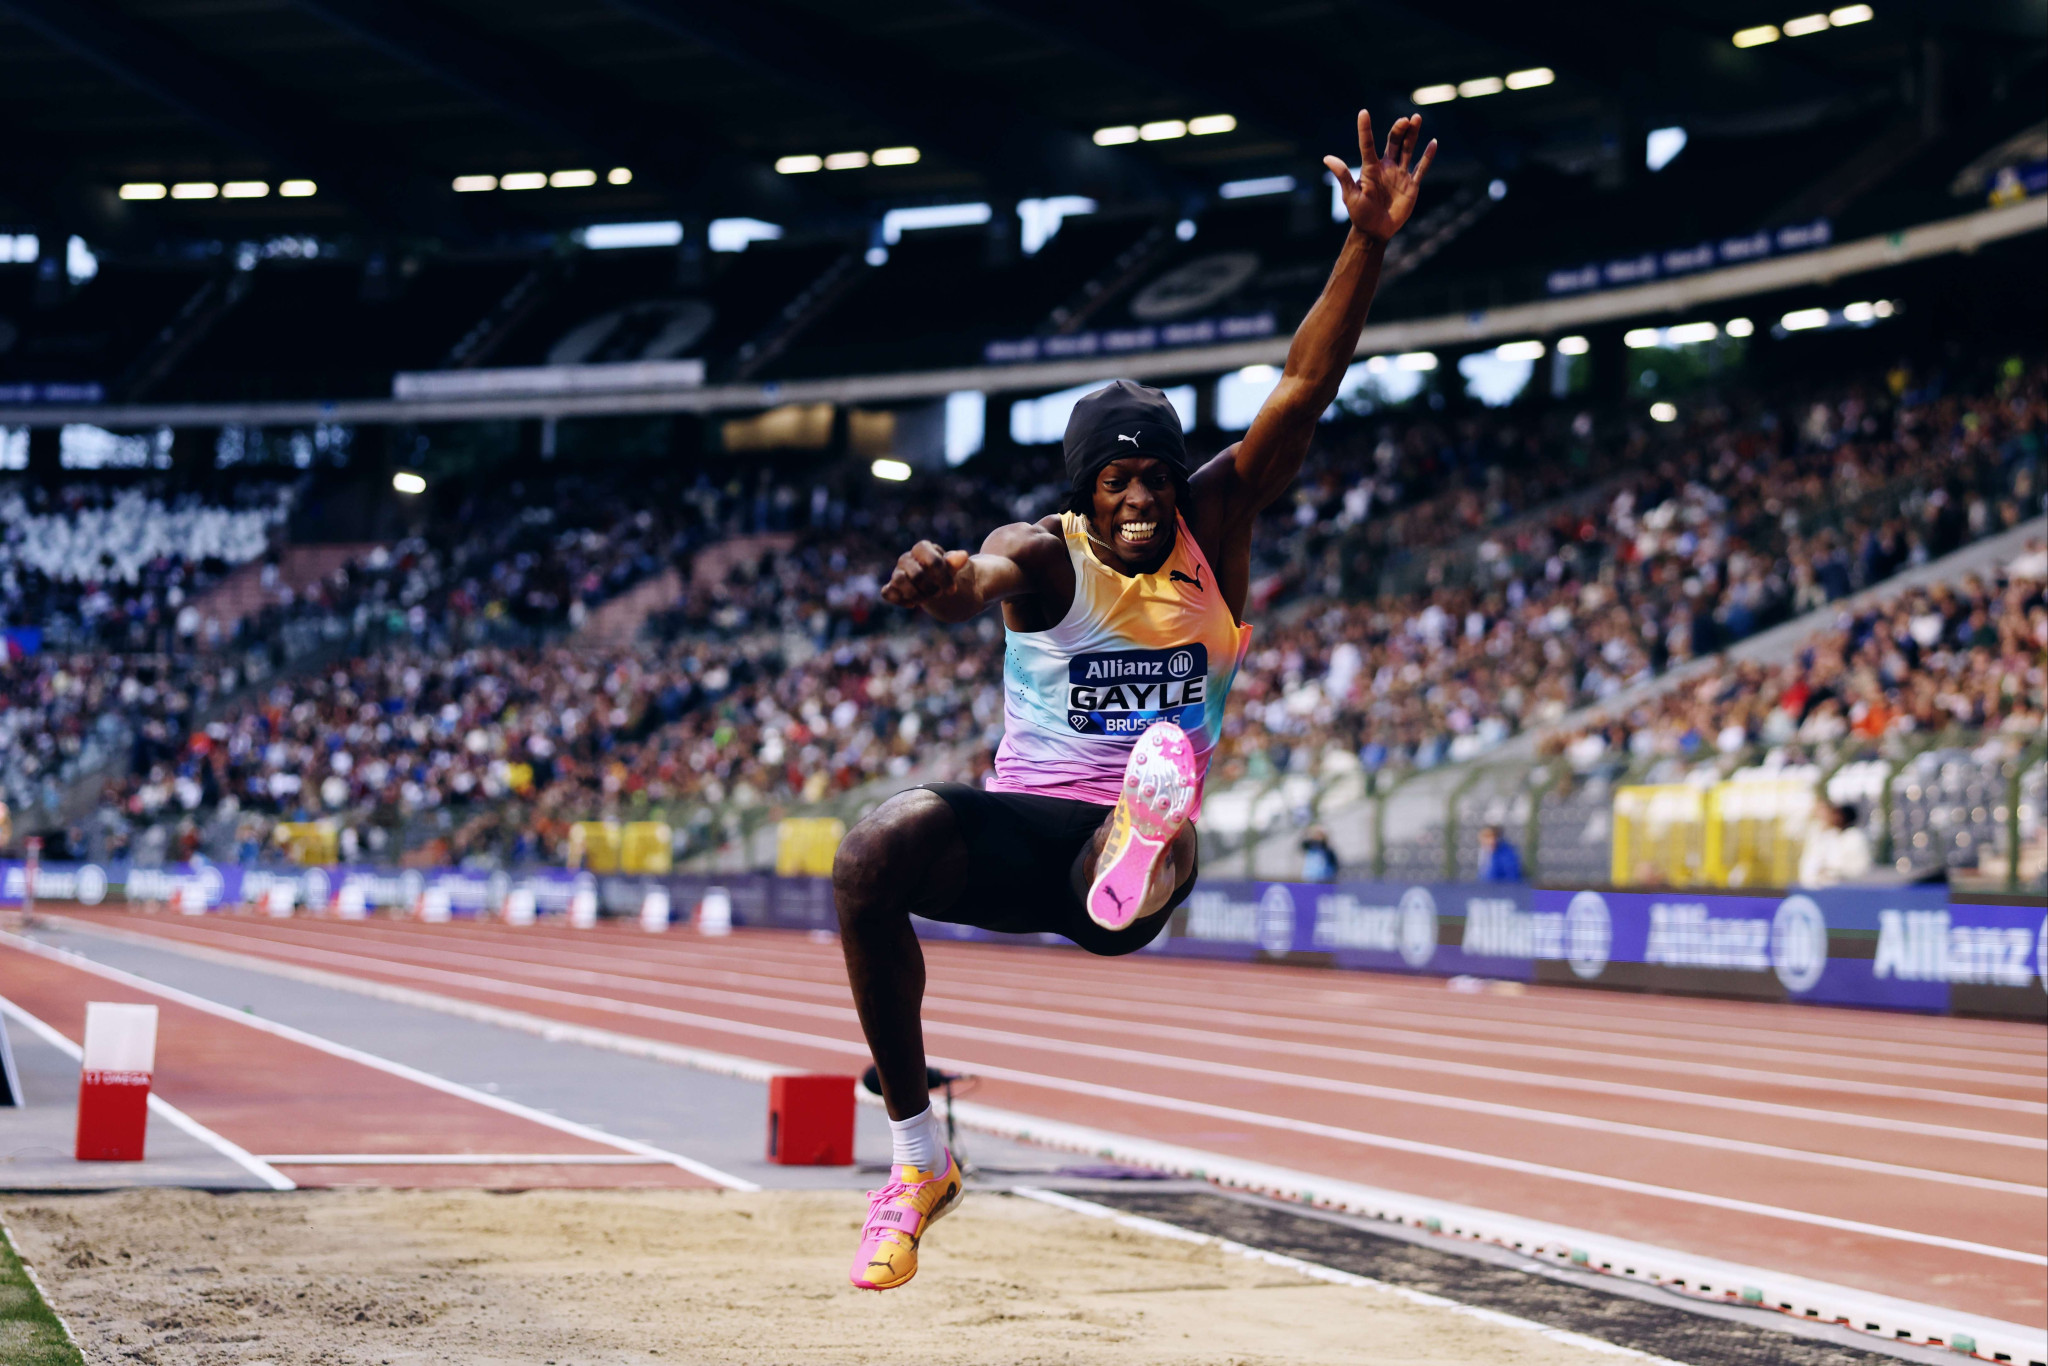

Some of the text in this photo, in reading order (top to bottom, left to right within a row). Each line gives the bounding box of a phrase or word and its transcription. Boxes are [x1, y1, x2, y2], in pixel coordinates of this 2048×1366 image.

[1085, 658, 1163, 679] Allianz
[1070, 676, 1204, 711] GAYLE
[1872, 908, 2035, 988] Allianz
